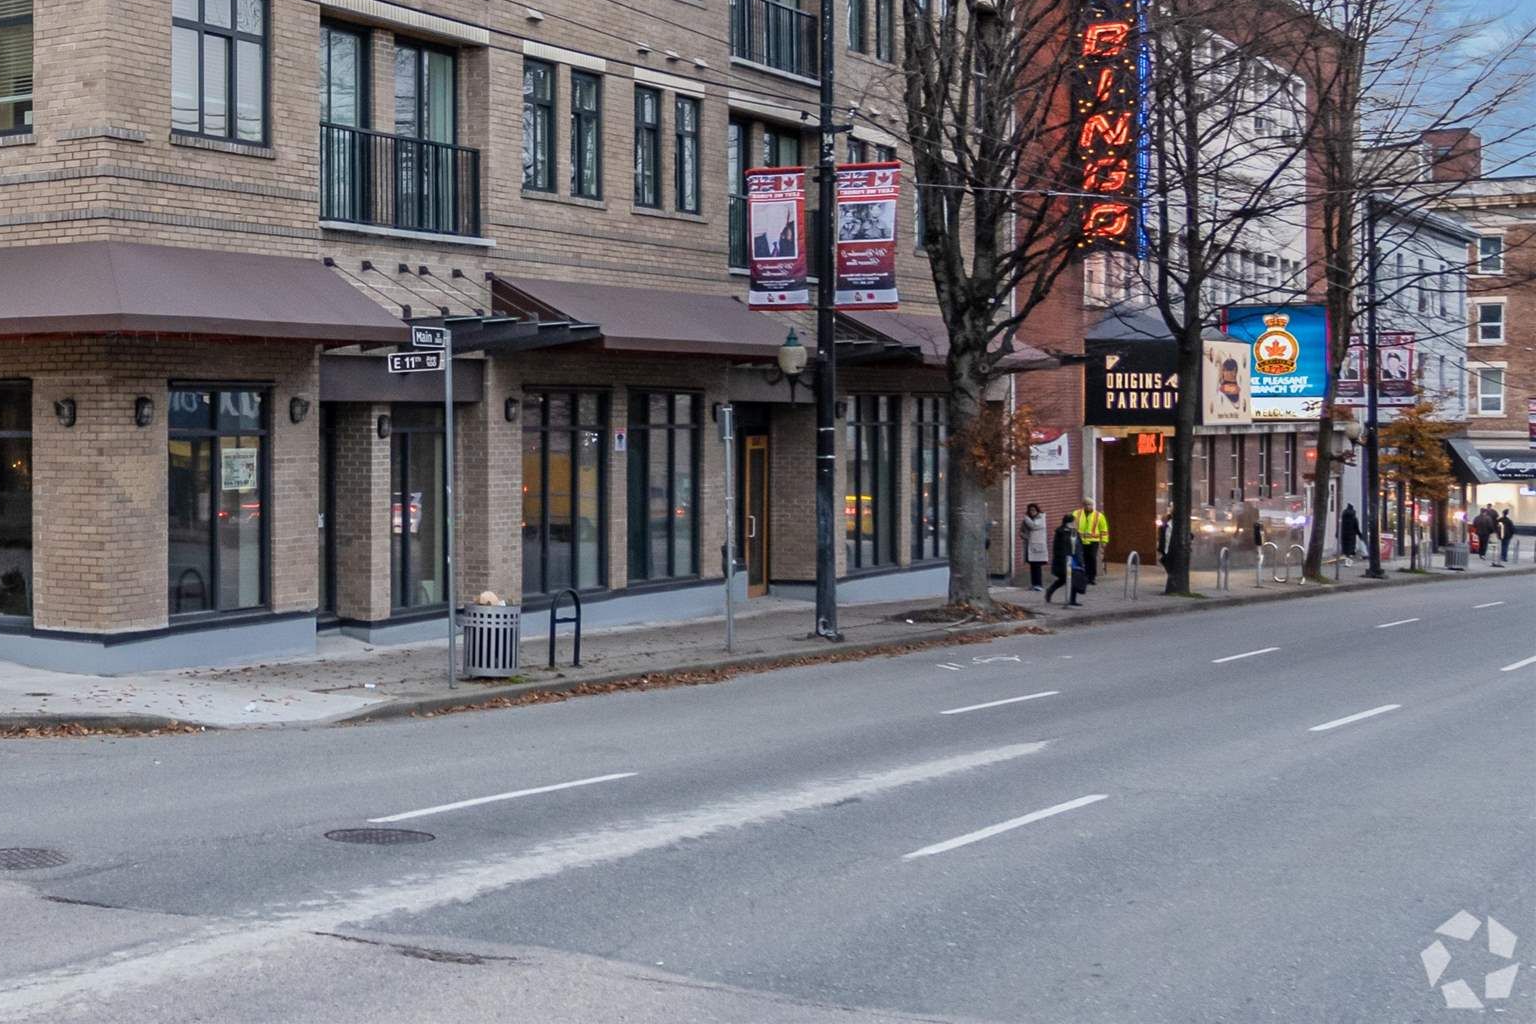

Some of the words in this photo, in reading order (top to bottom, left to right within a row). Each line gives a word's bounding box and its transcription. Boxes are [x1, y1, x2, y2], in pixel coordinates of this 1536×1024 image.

[1079, 22, 1132, 237] BINGO
[416, 331, 432, 343] Main
[394, 357, 401, 369] E
[1106, 372, 1162, 389] ORIGINS
[1262, 375, 1309, 386] PLEASANT
